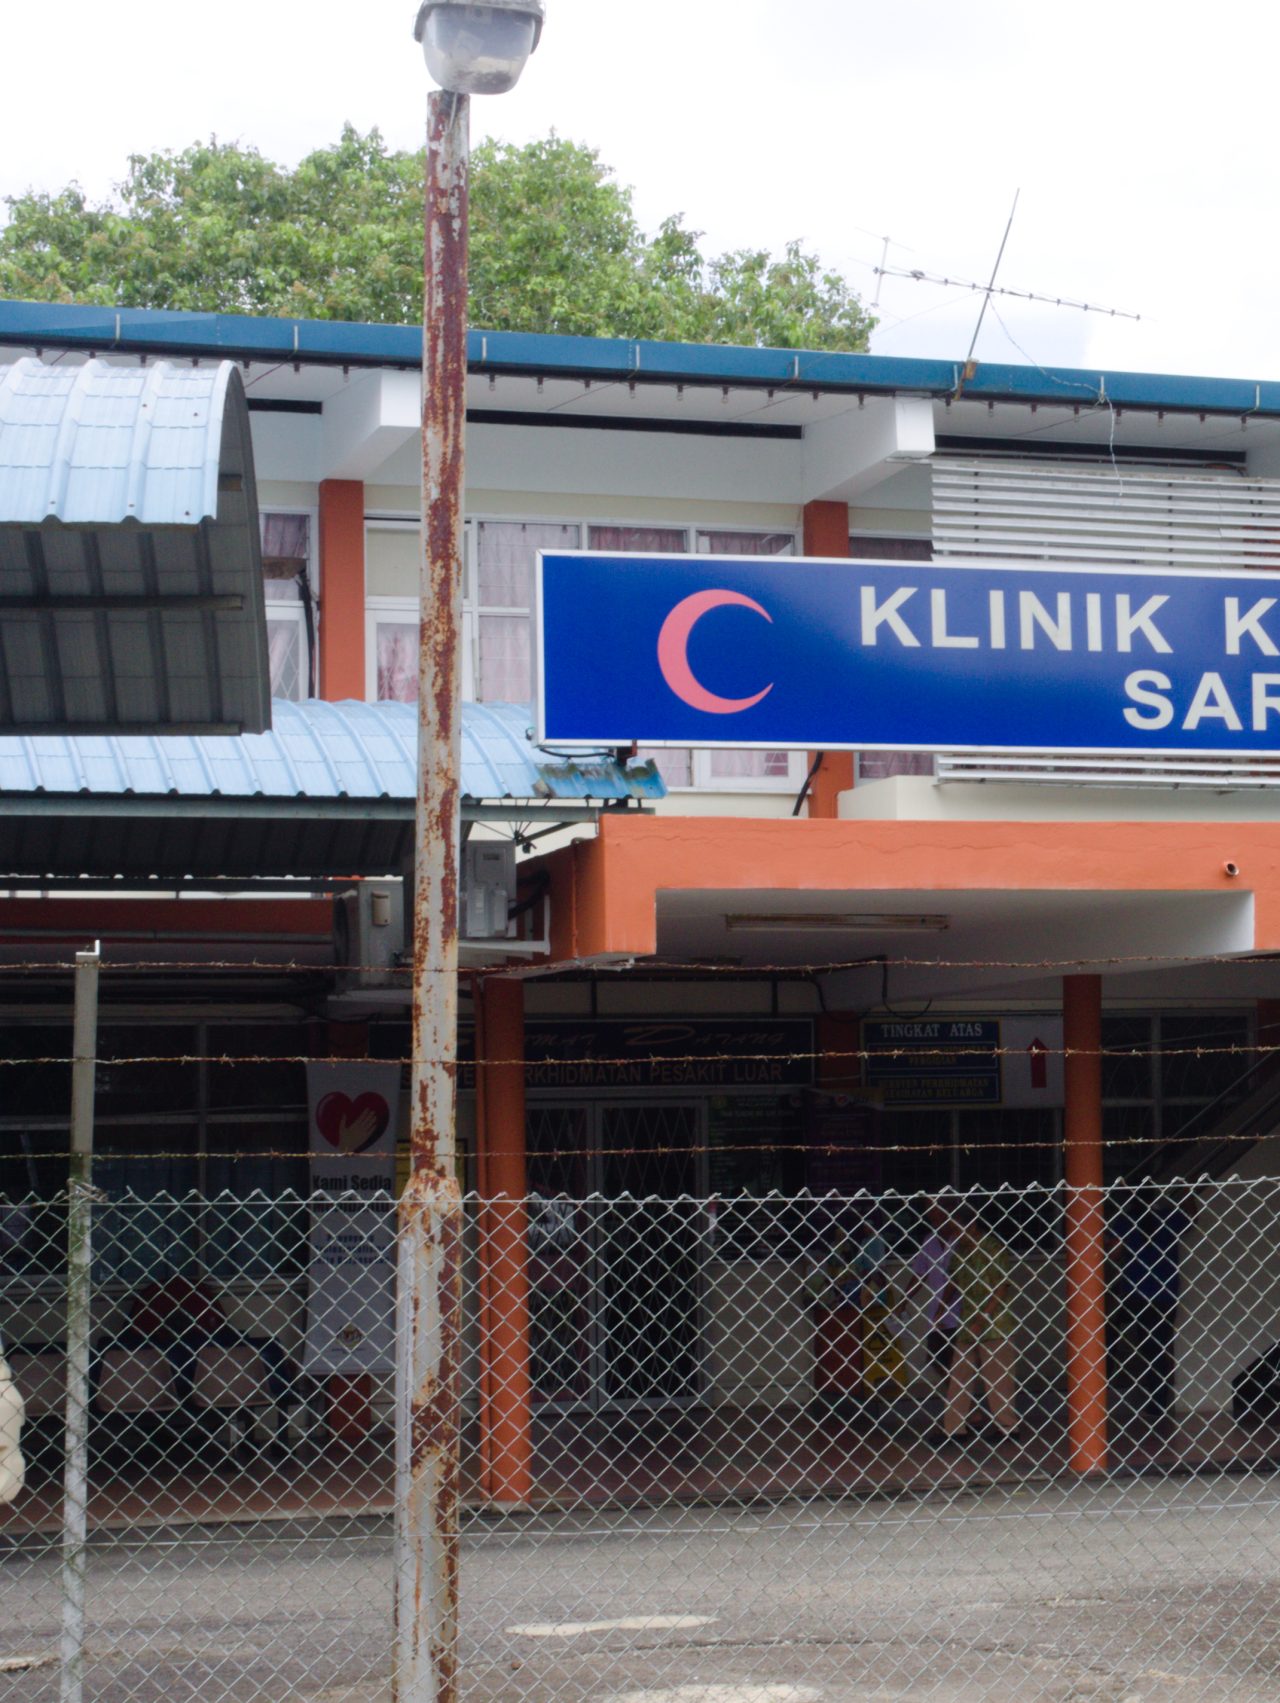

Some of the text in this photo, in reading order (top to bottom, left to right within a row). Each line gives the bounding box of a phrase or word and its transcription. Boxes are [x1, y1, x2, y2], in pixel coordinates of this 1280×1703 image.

[859, 585, 1174, 654] KLINIK
[880, 1022, 983, 1038] TINGKAT ATAS
[525, 1062, 783, 1084] RKHIDMATAN PESAKIT LUAR
[313, 1174, 391, 1190] Kami Sedia
